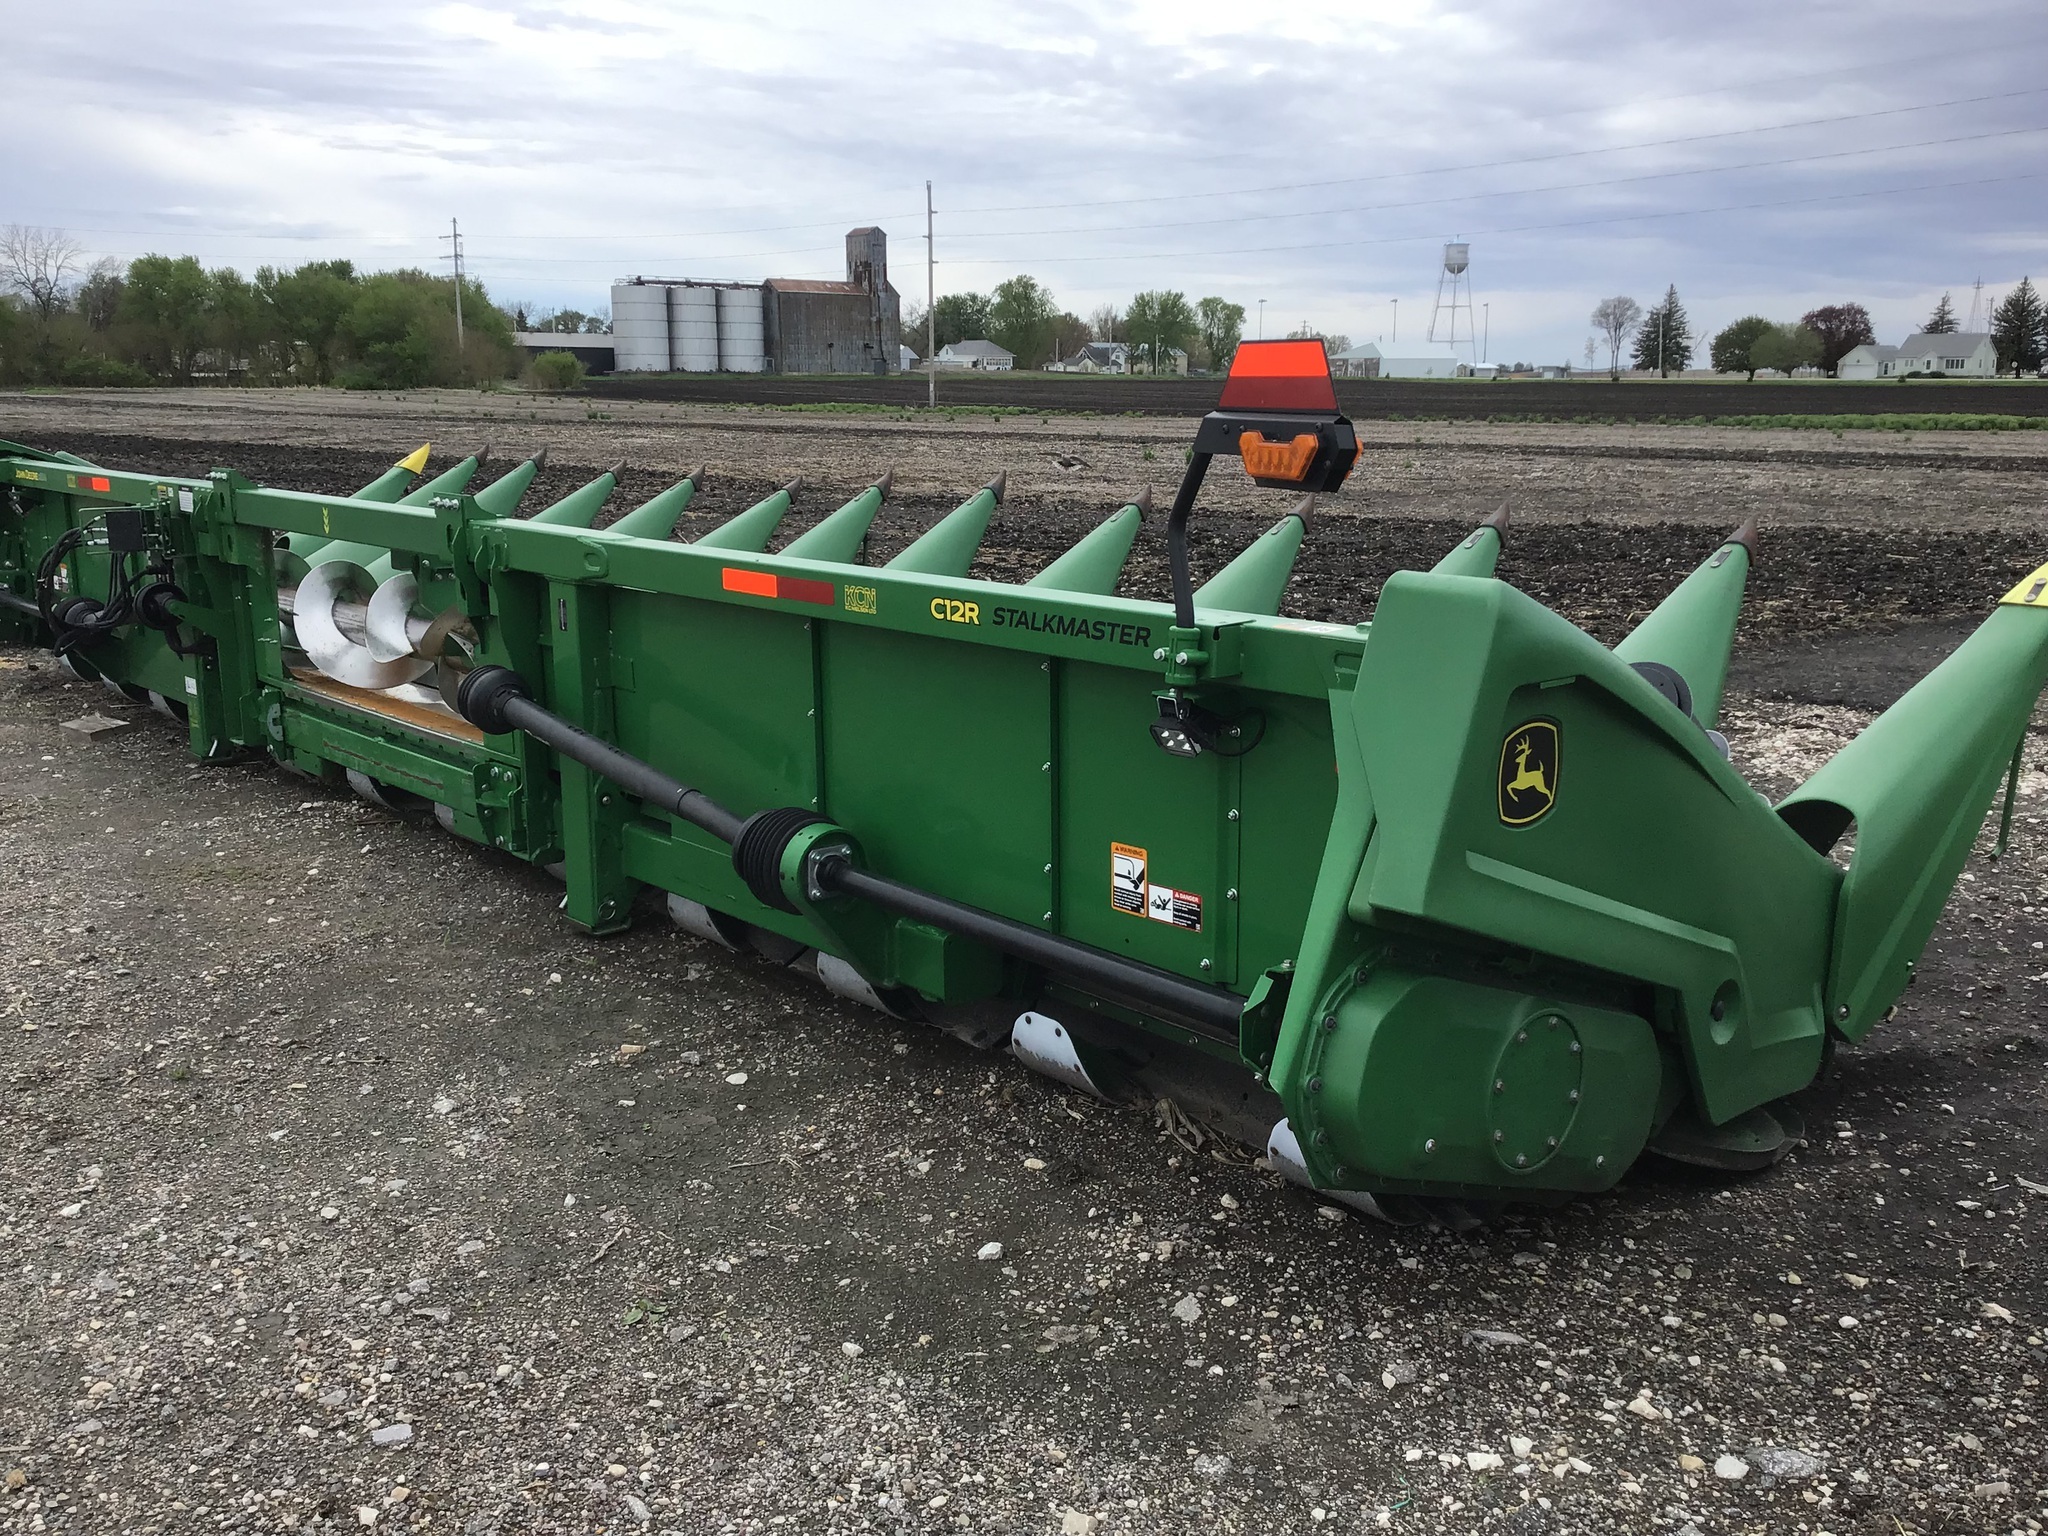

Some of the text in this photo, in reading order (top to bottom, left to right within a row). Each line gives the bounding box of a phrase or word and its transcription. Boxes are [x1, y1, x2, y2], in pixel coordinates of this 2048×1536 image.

[844, 584, 877, 610] KCN
[930, 597, 1151, 648] C12R STALKMASTER
[1179, 892, 1199, 903] DANGER
